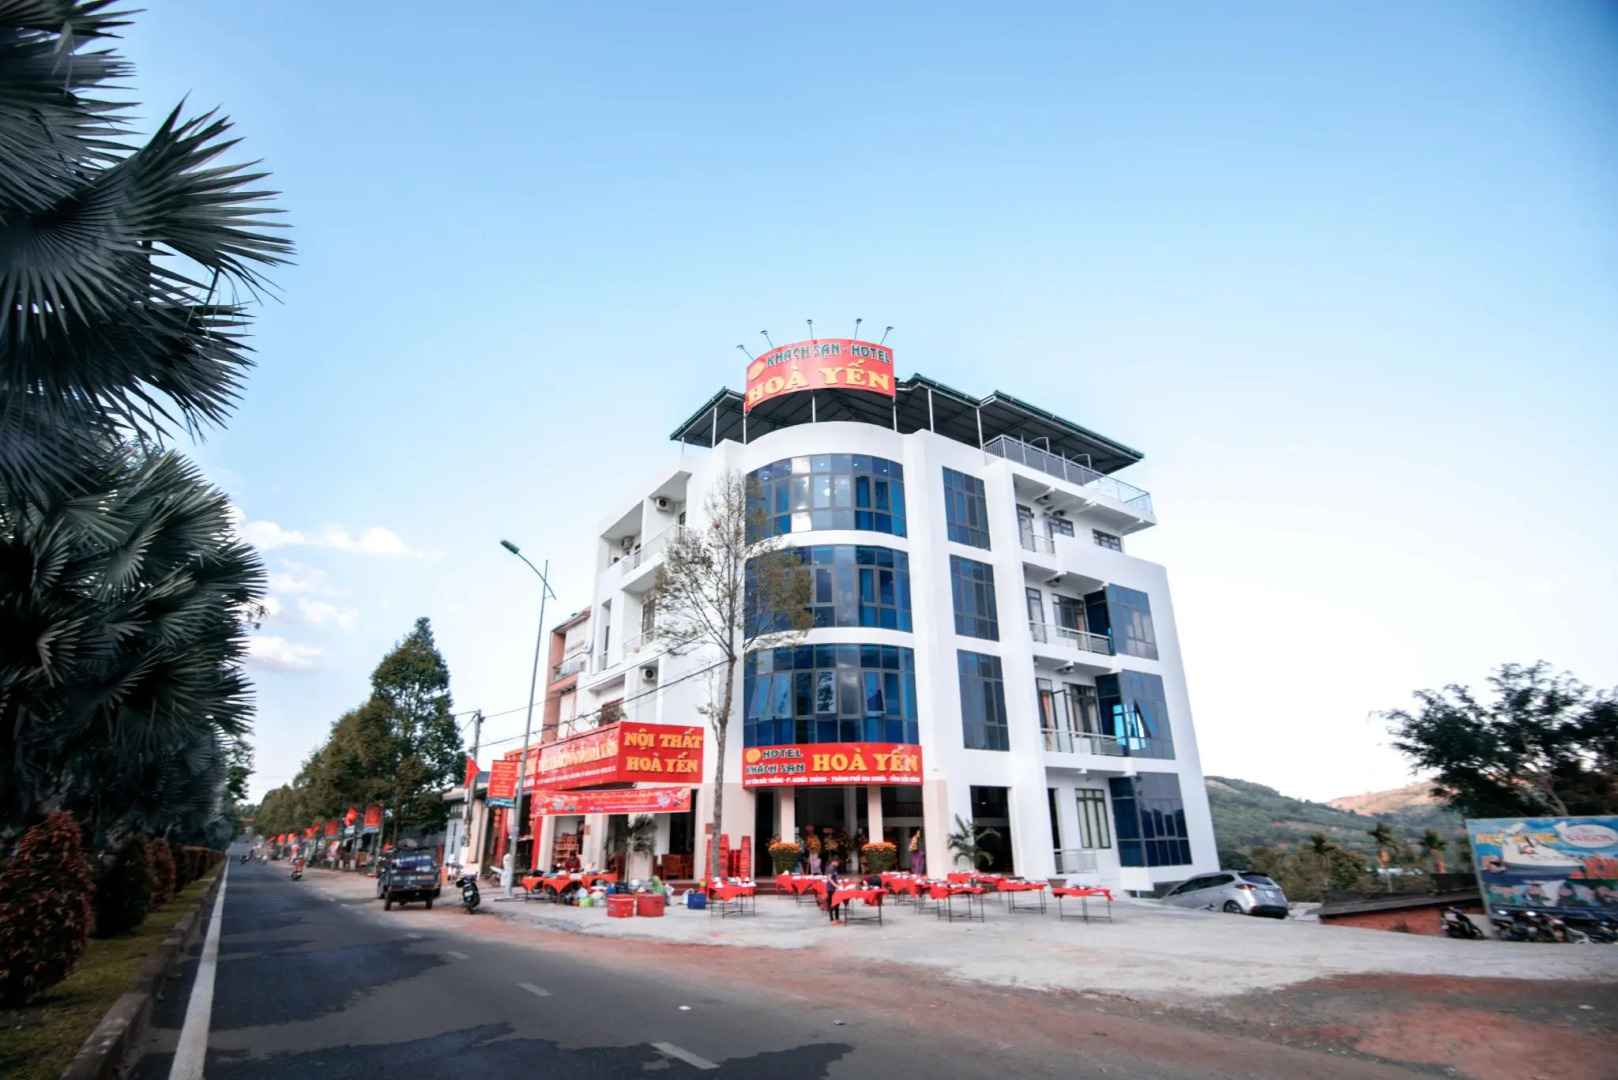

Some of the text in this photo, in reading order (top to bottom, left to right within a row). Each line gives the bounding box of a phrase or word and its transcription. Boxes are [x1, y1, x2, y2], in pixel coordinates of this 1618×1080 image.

[767, 344, 810, 367] KHÁCH
[813, 343, 841, 360] SẠN
[851, 344, 892, 364] HOTEL
[748, 358, 890, 406] HOÀ YẾN
[623, 727, 704, 751] NỘI THẤT
[625, 752, 663, 772] HOÀ
[664, 751, 698, 773] YẾN
[763, 748, 802, 760] HOTEL
[812, 745, 918, 773] HOÀ YẾN
[746, 763, 805, 776] KHÁCH SẠN
